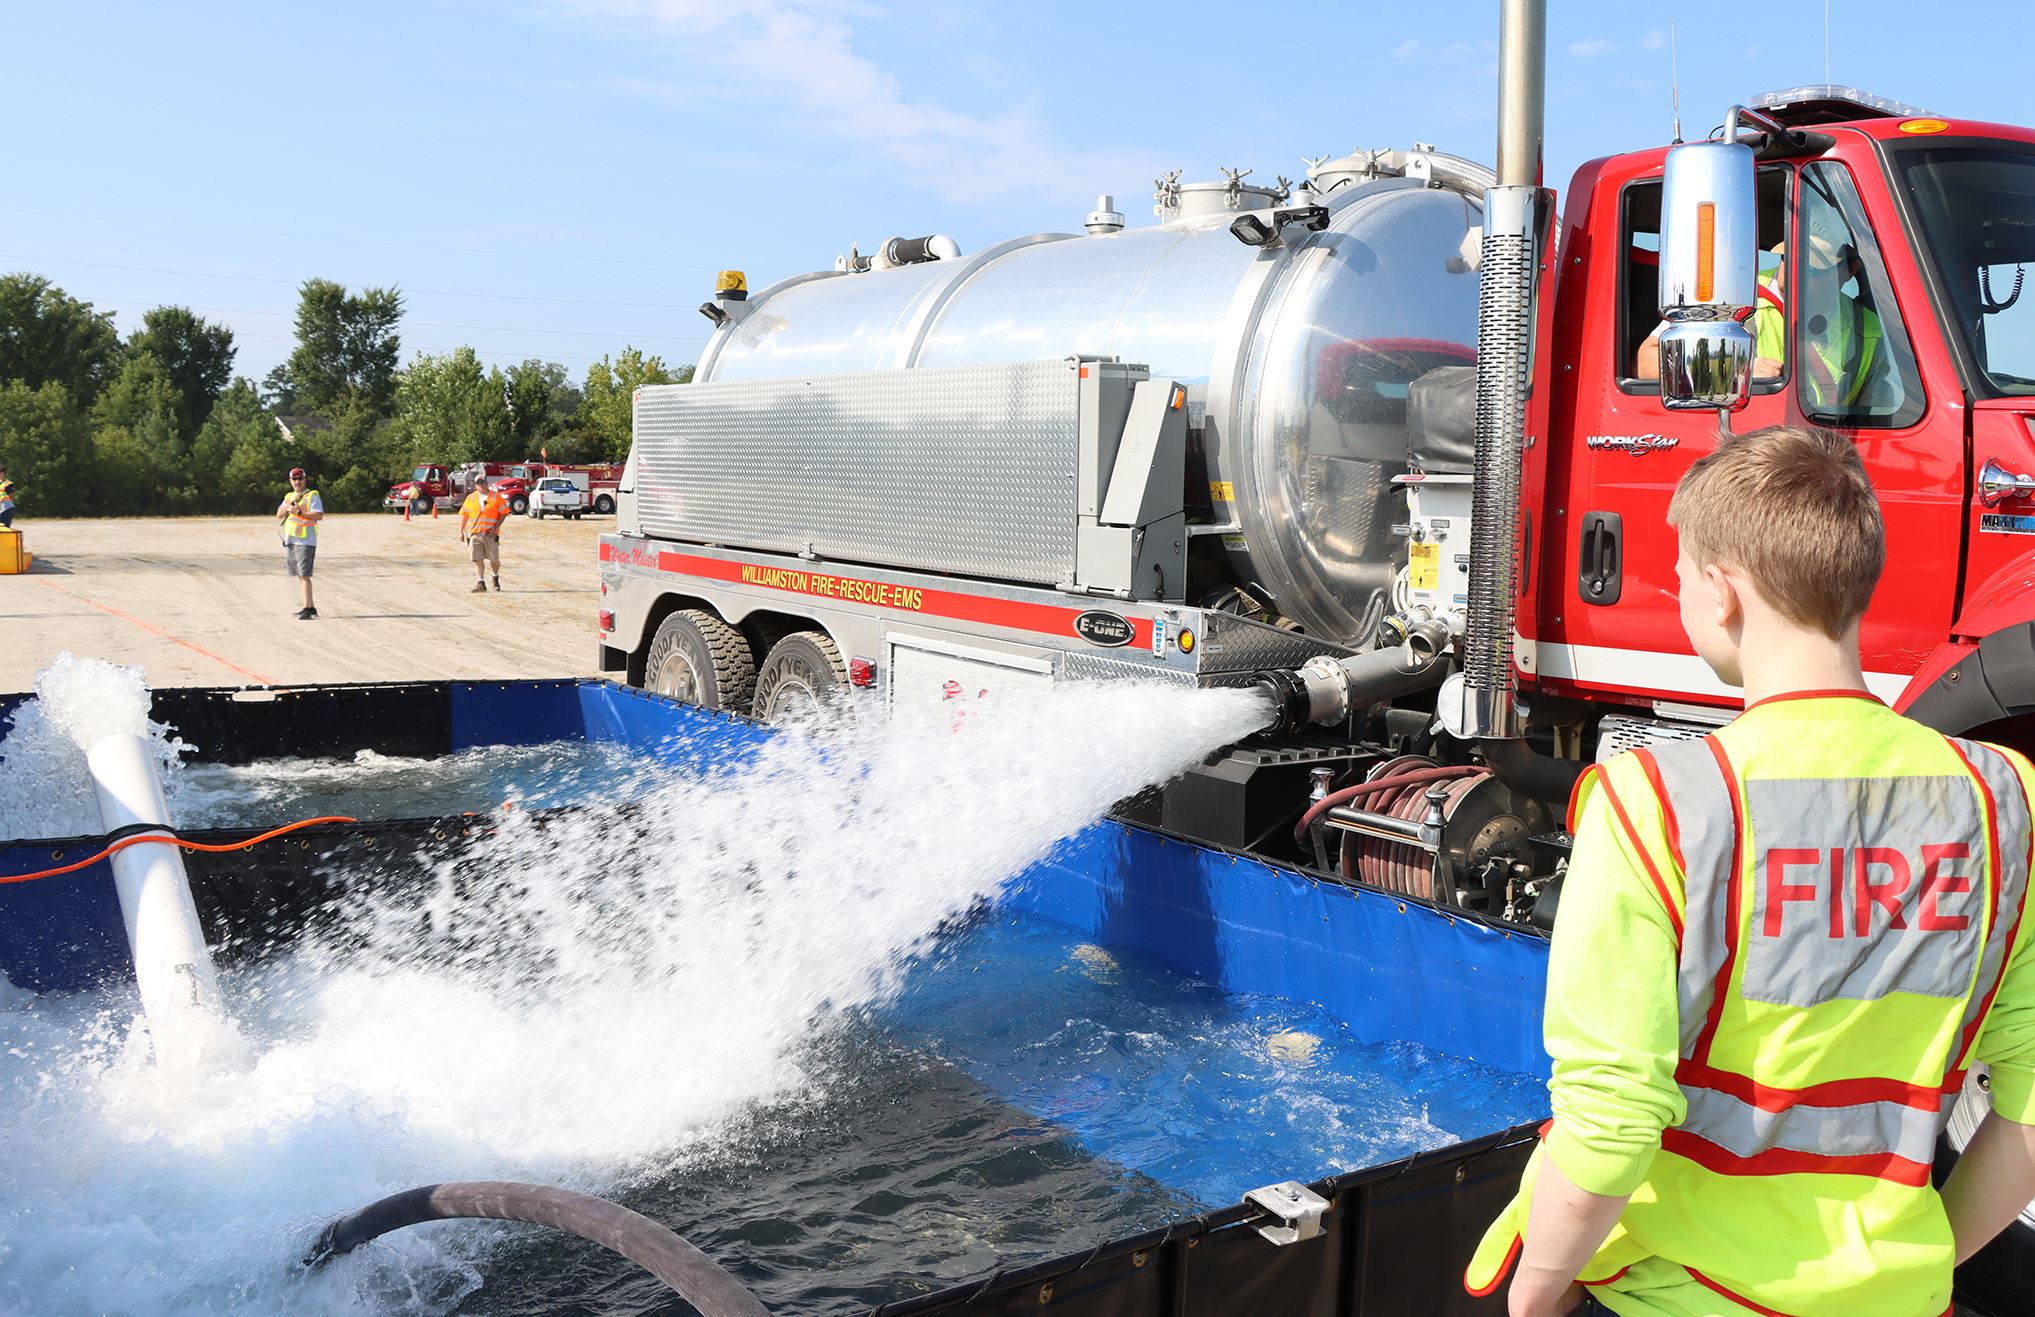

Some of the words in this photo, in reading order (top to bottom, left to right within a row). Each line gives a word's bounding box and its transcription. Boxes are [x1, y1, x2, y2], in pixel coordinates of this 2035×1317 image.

[741, 564, 808, 592] WILLIAMSTON
[810, 574, 922, 610] FIRE-RESCUE-EMS
[1079, 617, 1127, 639] E-ONE
[1762, 842, 1971, 939] FIRE
